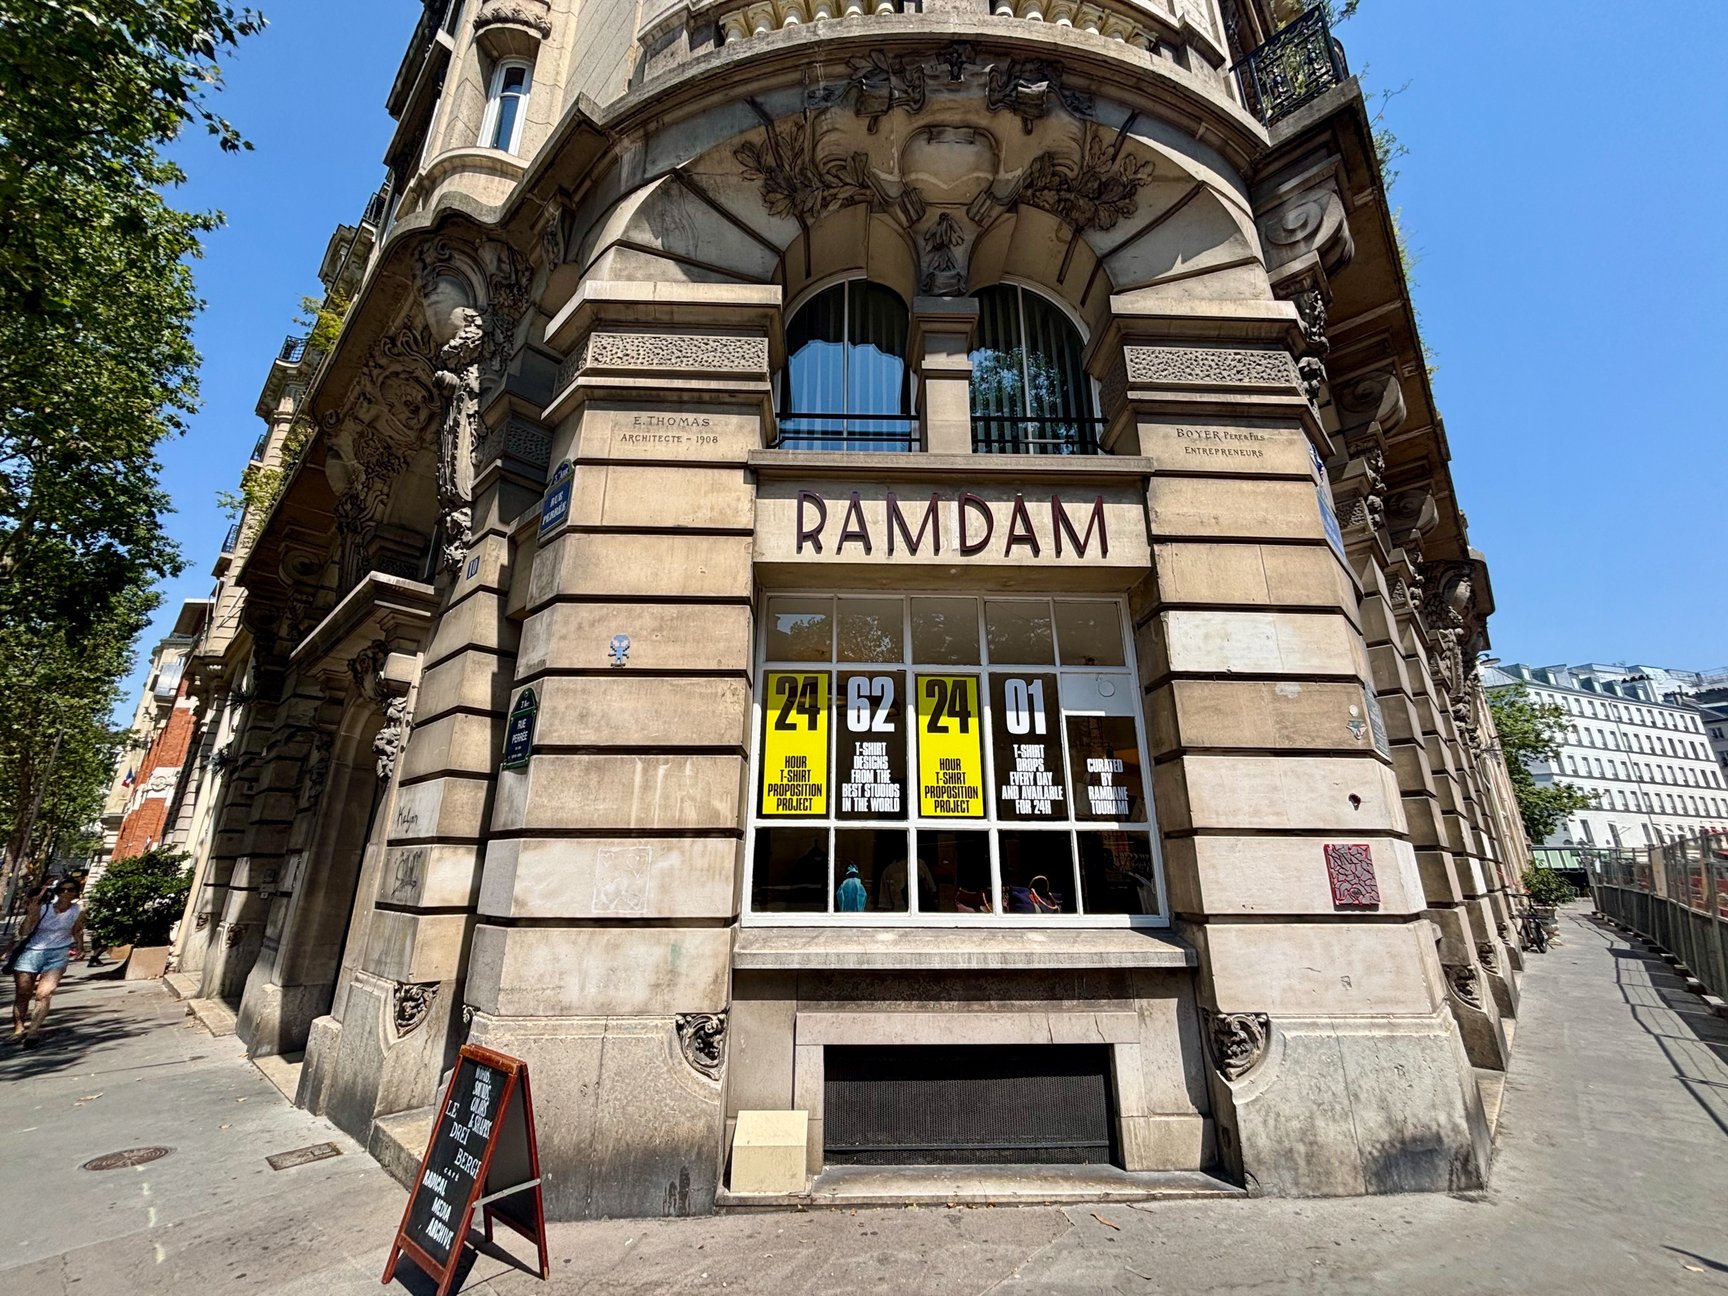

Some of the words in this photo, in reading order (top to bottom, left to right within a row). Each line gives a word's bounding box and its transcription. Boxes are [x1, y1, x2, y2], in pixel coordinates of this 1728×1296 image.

[620, 433, 682, 445] ARCHITECTE
[696, 435, 718, 445] 1908
[1176, 428, 1222, 442] BOYER
[1184, 446, 1264, 458] ENTREPRENEURS
[796, 490, 1109, 558] RAMDAM
[774, 676, 820, 731] 24
[847, 676, 895, 732] 62
[925, 678, 971, 734] 24
[1004, 678, 1047, 735] 01
[855, 742, 887, 755] T-SHIRT
[1013, 744, 1045, 758] T-SHIRT
[785, 756, 807, 768] HOUR
[854, 756, 888, 769] DESIGNS
[939, 758, 961, 771] HOUR
[1016, 758, 1045, 771] DROPS
[1087, 758, 1123, 772] CURATED
[780, 770, 811, 782] T-SHIRT
[851, 770, 874, 783] FROM
[876, 770, 891, 783] THE
[935, 772, 966, 785] T-SHIRT
[1010, 772, 1034, 785] EVERY
[1036, 772, 1053, 785] DAY
[1101, 772, 1112, 786] BY
[768, 784, 822, 797] PROPOSITION
[842, 784, 863, 797] BEST
[864, 784, 900, 797] STUDIOS
[924, 786, 979, 799] PROPOSITION
[1002, 785, 1019, 799] AND
[1022, 785, 1063, 800] AVAILABLE
[1088, 786, 1128, 800] RAMDANE
[776, 798, 812, 811] PROJECT
[842, 798, 851, 812] IN
[853, 798, 869, 812] THE
[870, 798, 900, 812] WORLD
[934, 800, 969, 813] PROJECT
[1015, 800, 1032, 814] FOR
[1033, 800, 1052, 814] 24H
[1090, 801, 1129, 814] TOUHAMI
[445, 1100, 460, 1118] LE
[449, 1121, 471, 1145] DREI
[422, 1169, 448, 1197] RADICAL
[431, 1197, 452, 1222] MEDIA
[425, 1217, 454, 1250] ARCHIVE
